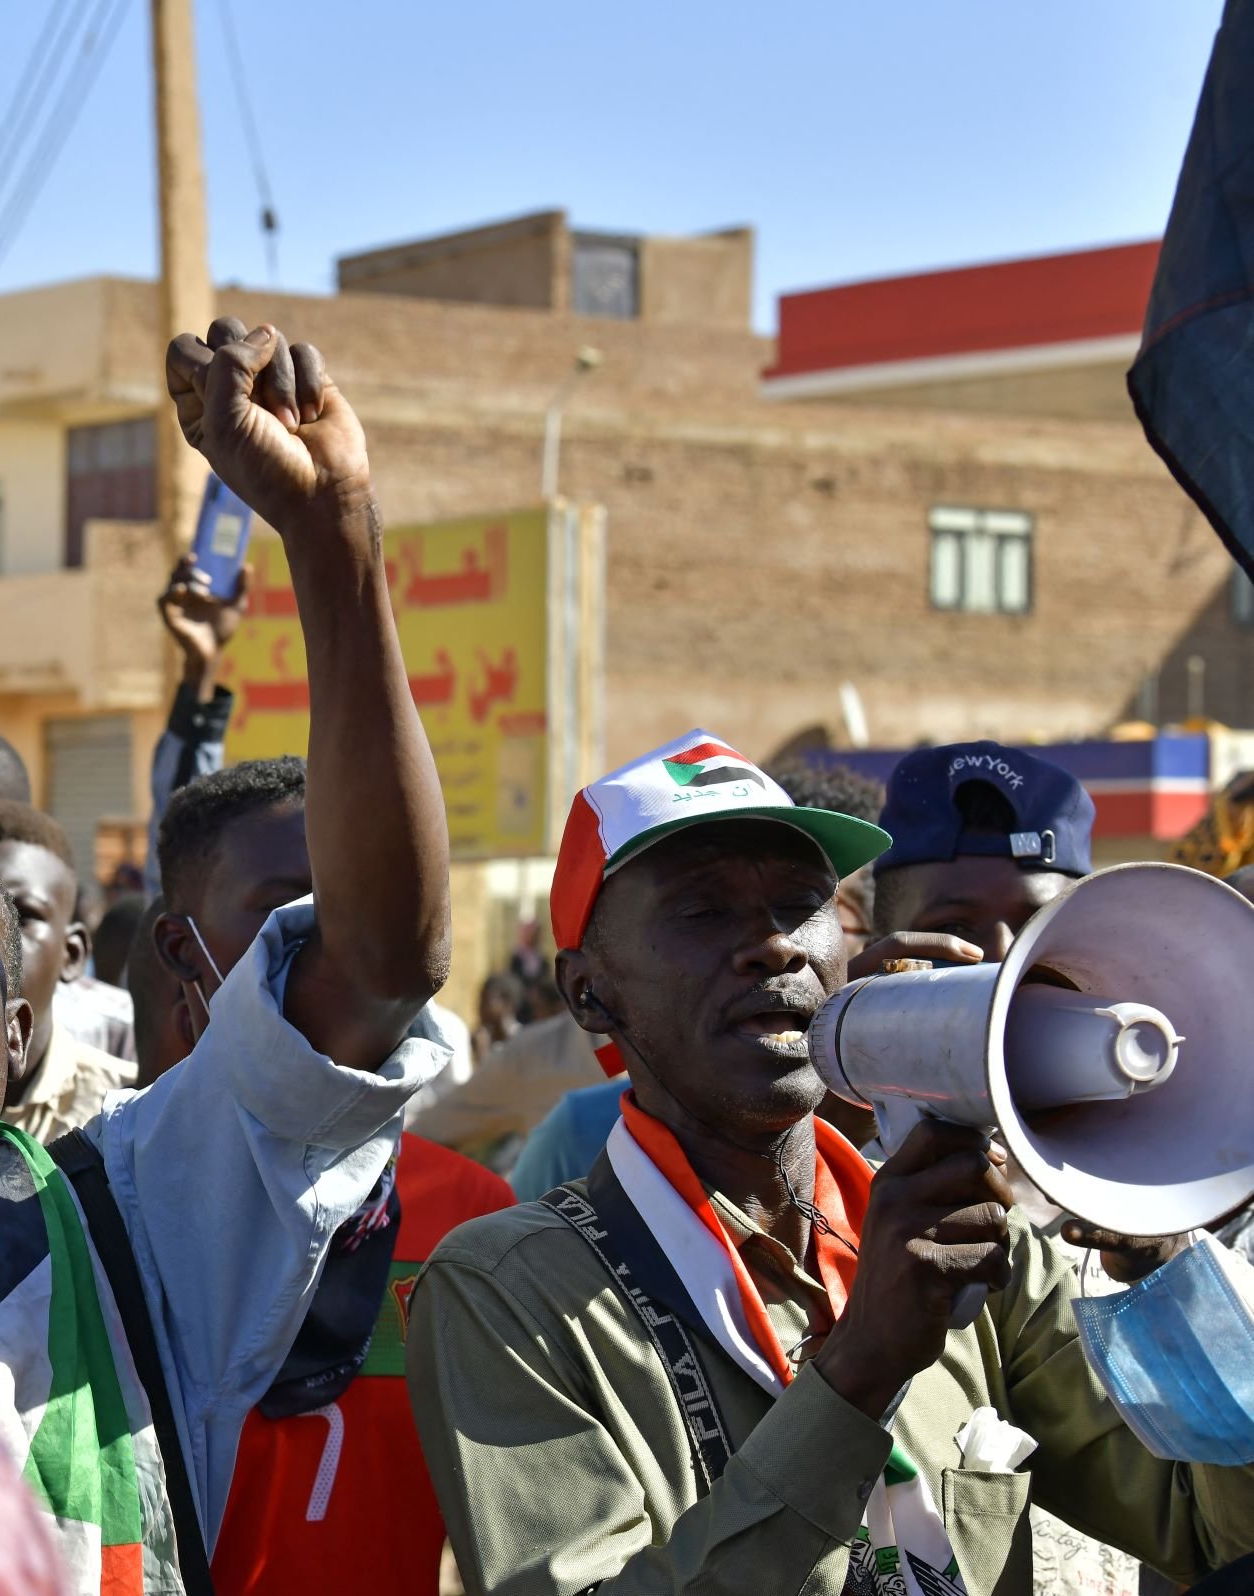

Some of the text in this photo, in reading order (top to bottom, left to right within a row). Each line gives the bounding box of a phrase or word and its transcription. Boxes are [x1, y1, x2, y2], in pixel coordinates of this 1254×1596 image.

[556, 1195, 609, 1241] FILA
[672, 1352, 721, 1442] FILA
[297, 1402, 345, 1522] 7
